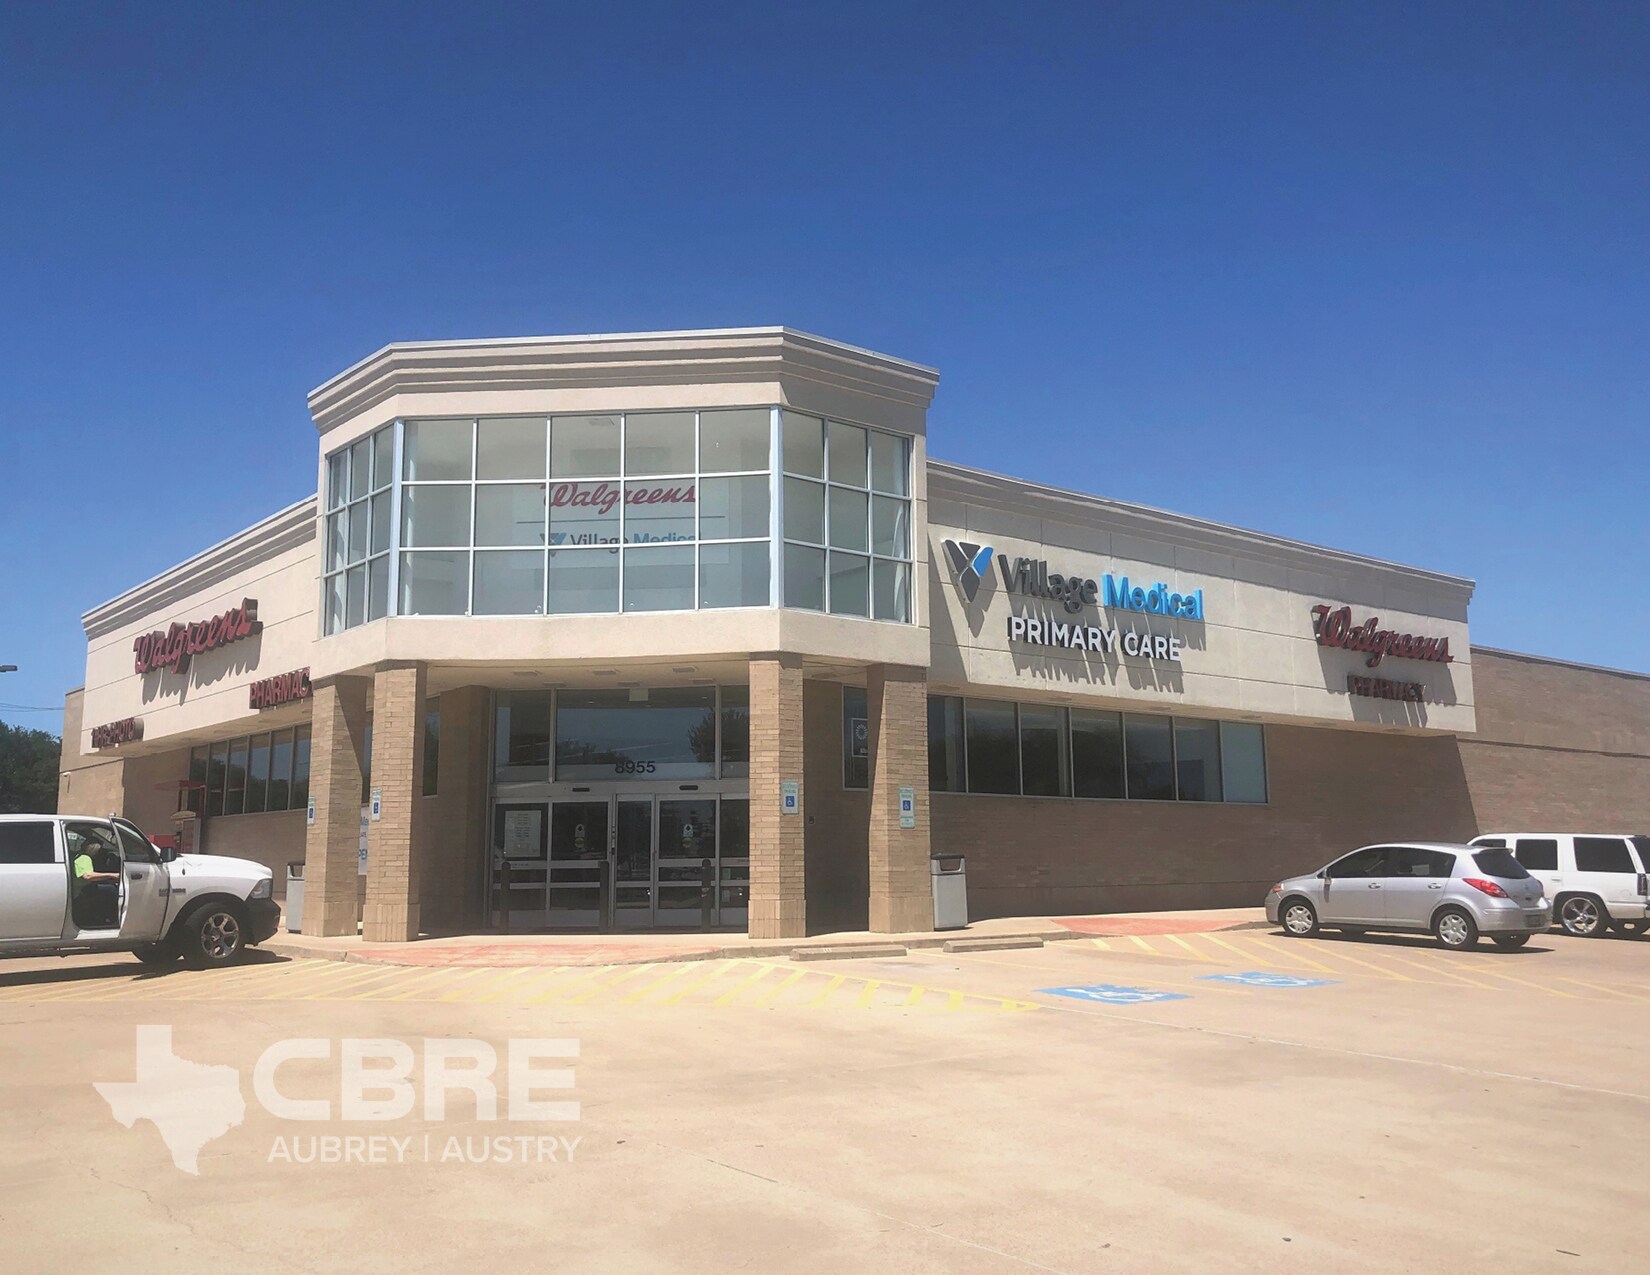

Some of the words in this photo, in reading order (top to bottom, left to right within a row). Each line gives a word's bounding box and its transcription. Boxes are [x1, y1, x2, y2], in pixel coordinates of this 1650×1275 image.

[539, 482, 700, 515] Walgreens
[633, 532, 701, 544] Medic
[997, 554, 1099, 614] Village
[1102, 573, 1204, 620] Medical
[133, 597, 262, 674] Walgreens
[1007, 616, 1116, 654] PRIMARY
[1121, 632, 1181, 662] CARE
[1311, 604, 1454, 668] Walgreens
[249, 666, 313, 709] PHARMAC
[615, 760, 656, 774] 8955
